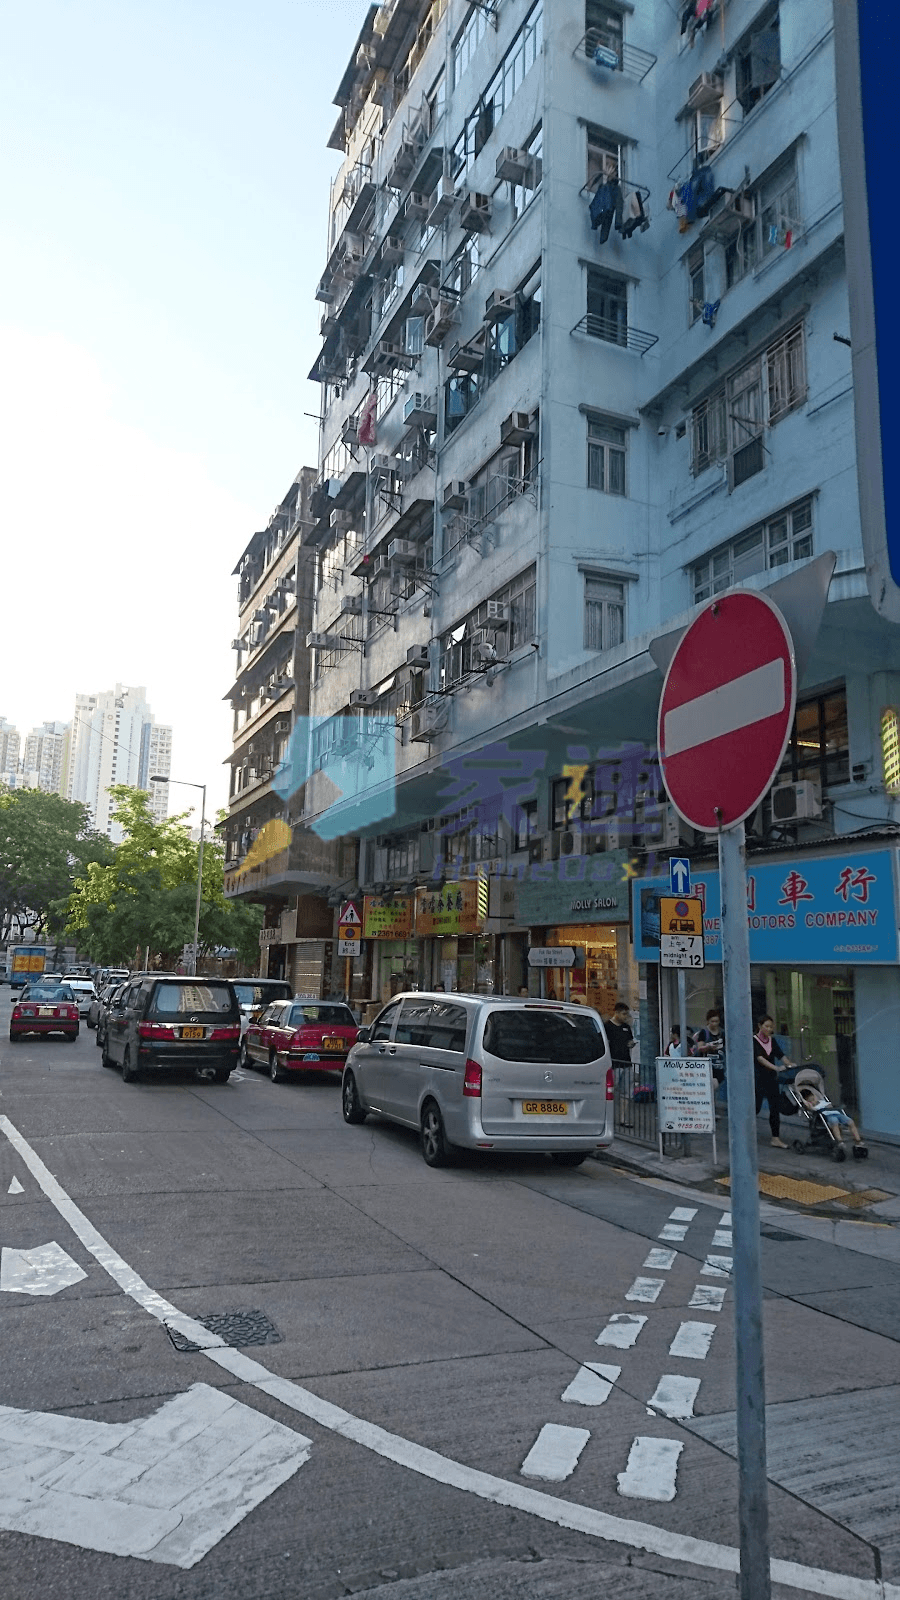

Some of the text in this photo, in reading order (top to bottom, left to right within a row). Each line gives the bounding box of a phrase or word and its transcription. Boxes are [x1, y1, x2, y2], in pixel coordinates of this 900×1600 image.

[571, 897, 617, 910] MOLLY SALON
[806, 910, 878, 927] COMPANY
[688, 937, 695, 948] 7
[689, 955, 701, 966] 12
[663, 1061, 705, 1069] Molly Salon
[525, 1103, 565, 1113] GR 8886
